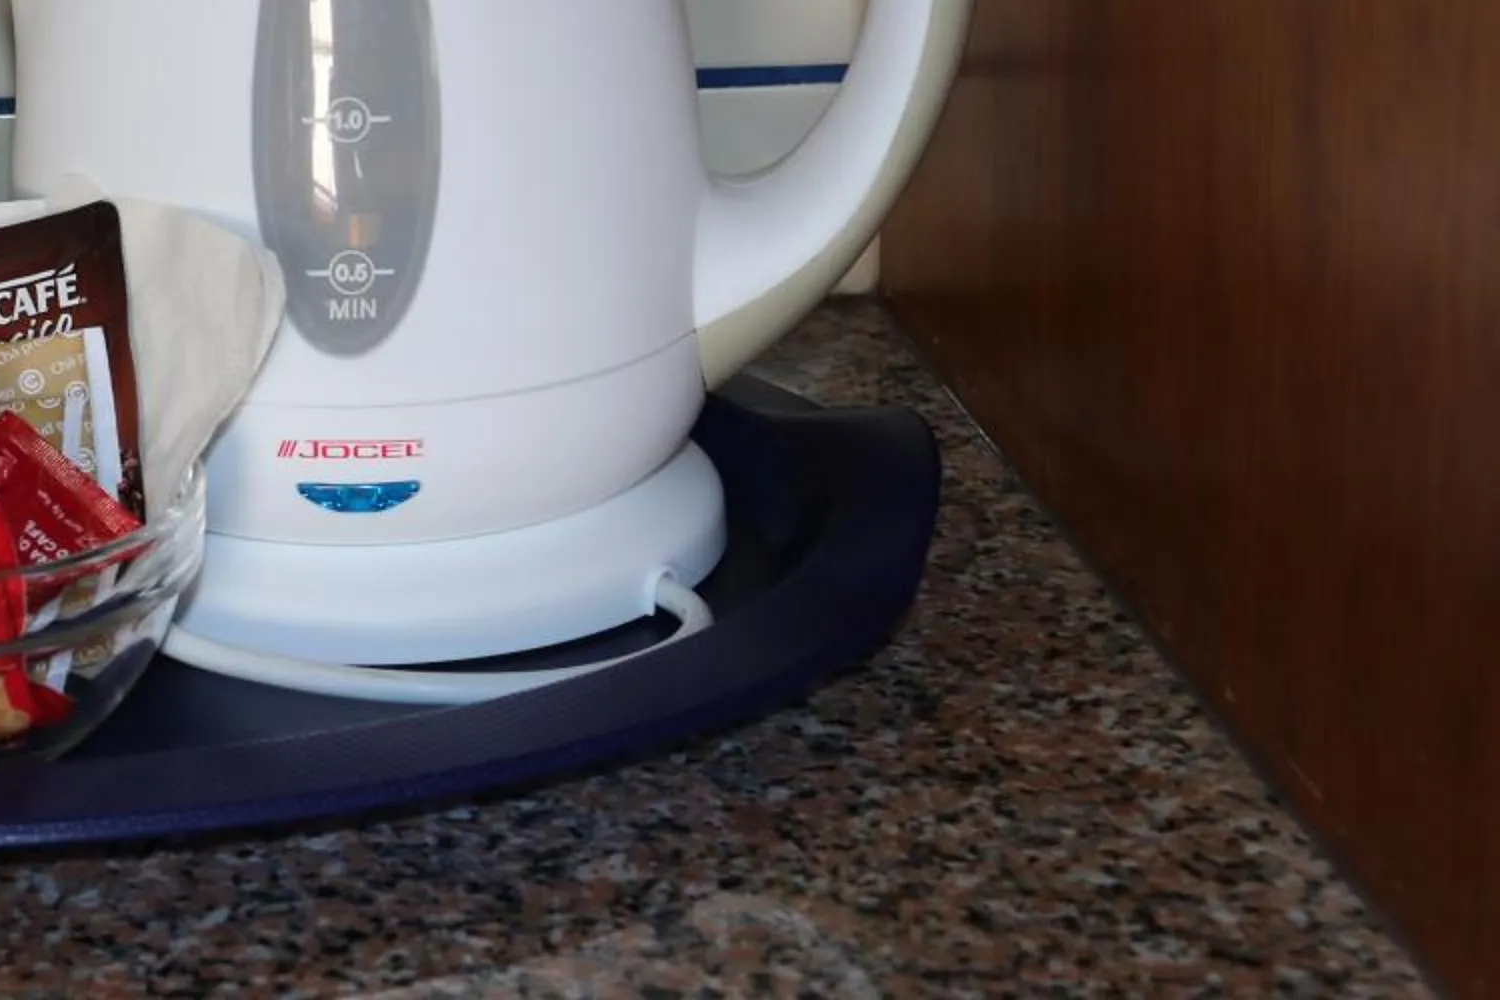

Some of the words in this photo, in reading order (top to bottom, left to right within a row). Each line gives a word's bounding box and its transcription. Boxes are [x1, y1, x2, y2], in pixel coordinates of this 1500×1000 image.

[332, 109, 364, 131] 1.0
[333, 262, 369, 283] 0.5
[328, 297, 378, 321] MIN
[299, 437, 426, 459] JOCEL
